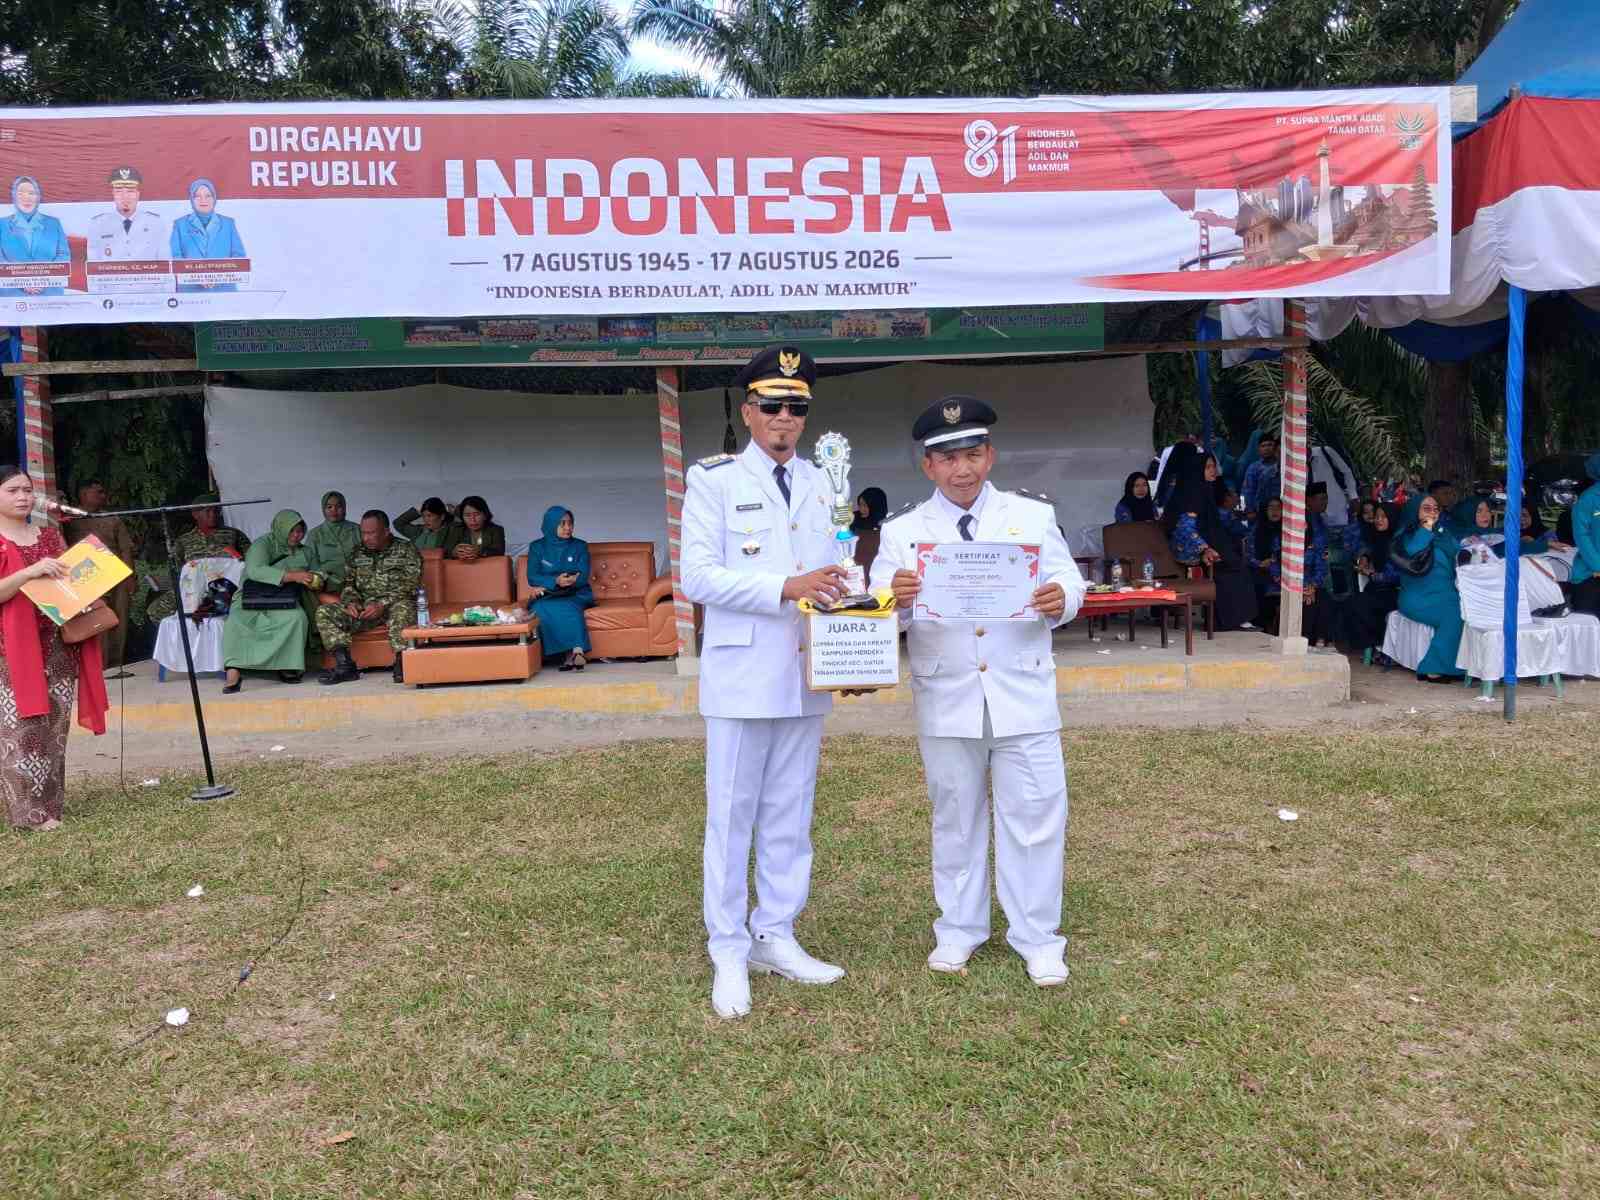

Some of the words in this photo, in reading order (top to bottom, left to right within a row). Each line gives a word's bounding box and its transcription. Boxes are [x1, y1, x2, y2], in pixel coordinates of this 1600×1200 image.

[1290, 115, 1319, 126] SUPRA
[1321, 114, 1357, 125] MANTRA
[1027, 129, 1076, 138] INDONESIA
[1328, 126, 1357, 135] TANAH
[249, 126, 422, 152] DIRGAHAYU
[1027, 140, 1079, 149] BERDAULAT
[964, 119, 1021, 185] 81
[1027, 151, 1049, 161] ADIL
[1050, 151, 1069, 161] DAN
[250, 160, 398, 187] REPUBLIK
[1027, 163, 1070, 172] MAKMUR
[444, 156, 953, 237] INDONESIA
[503, 252, 524, 273] 17
[531, 252, 632, 272] AGUSTUS
[638, 252, 690, 272] 1945
[710, 252, 732, 271] 17
[738, 251, 838, 271] AGUSTUS
[844, 250, 900, 269] 2026
[608, 284, 724, 299] BERDAULAT,
[730, 284, 774, 298] ADIL
[780, 284, 818, 297] DAN
[827, 622, 868, 634] JUARA
[870, 622, 878, 633] 2
